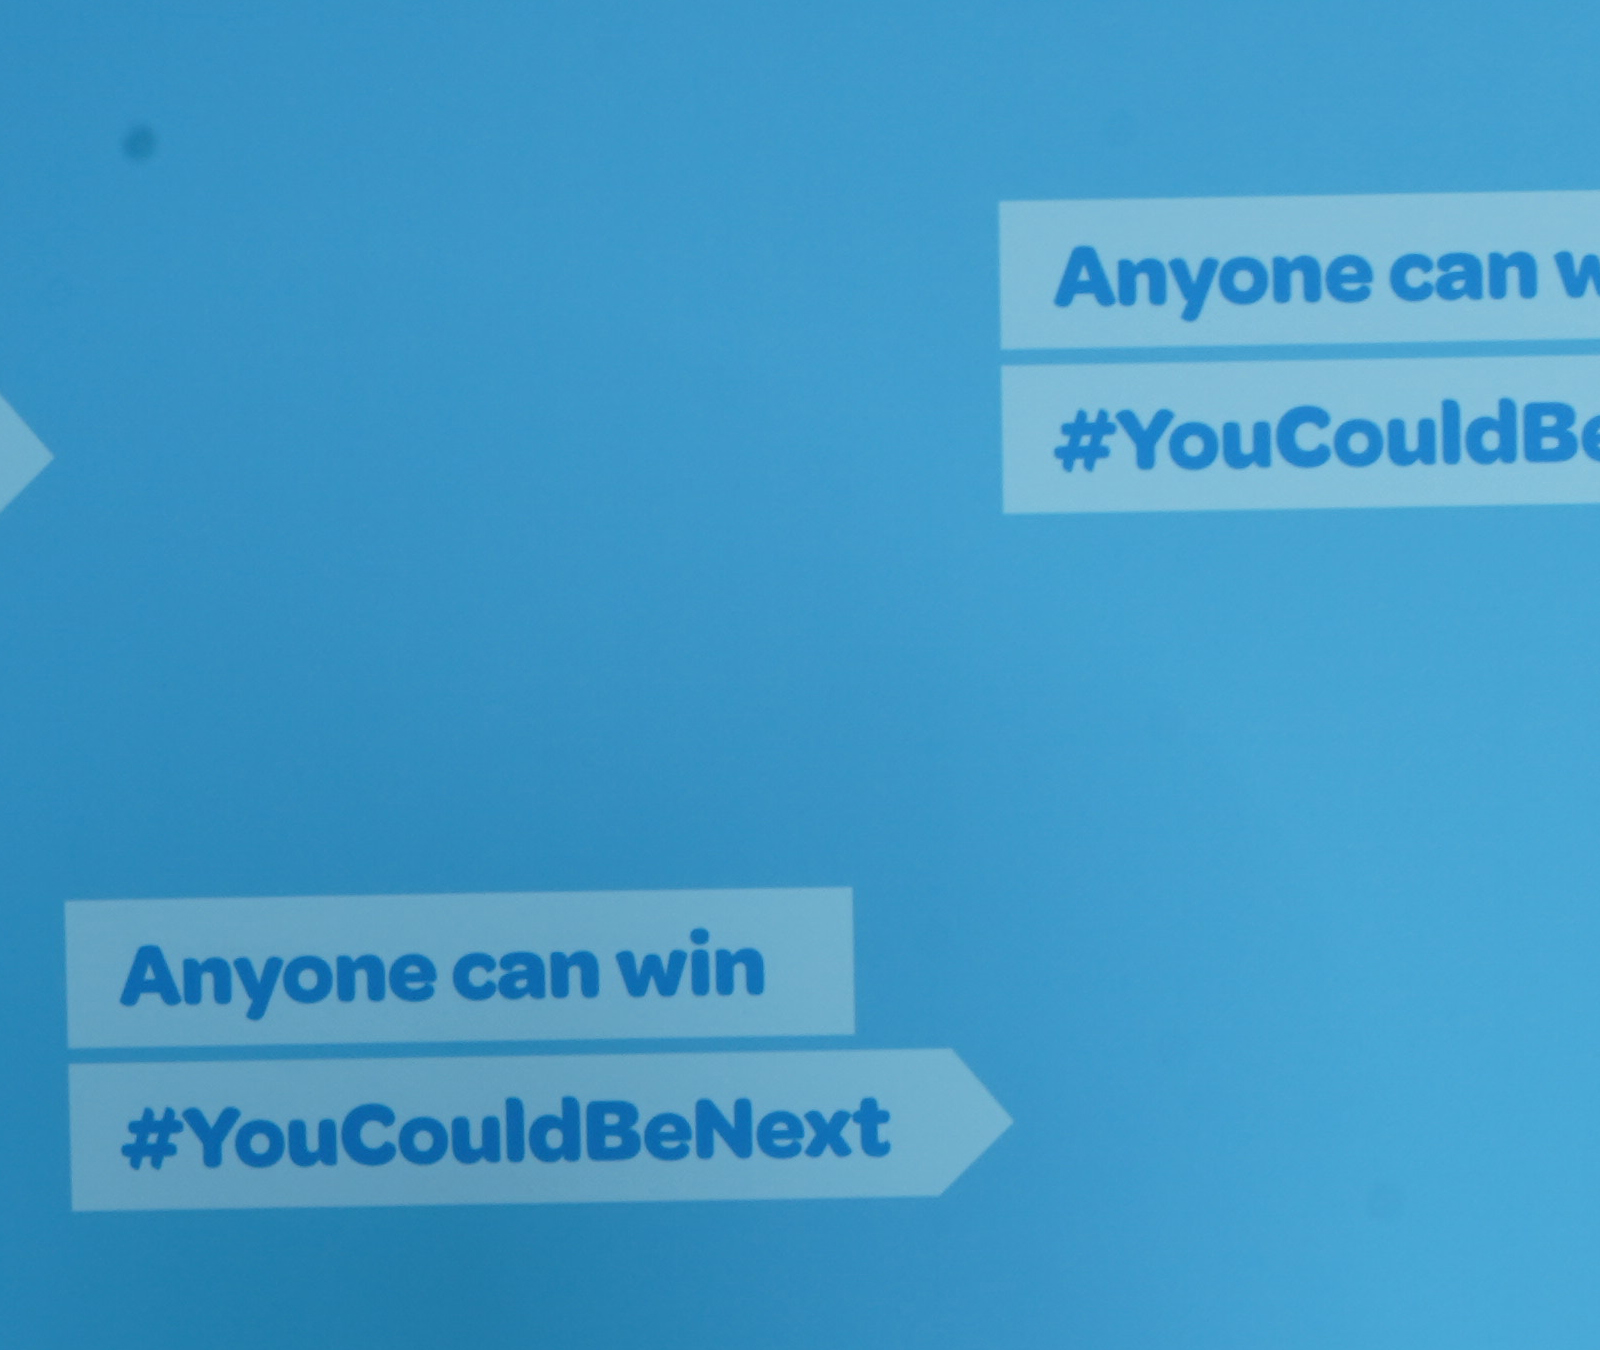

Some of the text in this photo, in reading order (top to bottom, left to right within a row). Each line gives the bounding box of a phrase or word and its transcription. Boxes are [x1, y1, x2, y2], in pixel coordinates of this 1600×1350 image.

[1054, 244, 1374, 322] Anyone
[1390, 251, 1538, 302] can
[120, 928, 765, 1021] Anyone can win
[121, 1096, 890, 1169] #YouCouldBeNext
